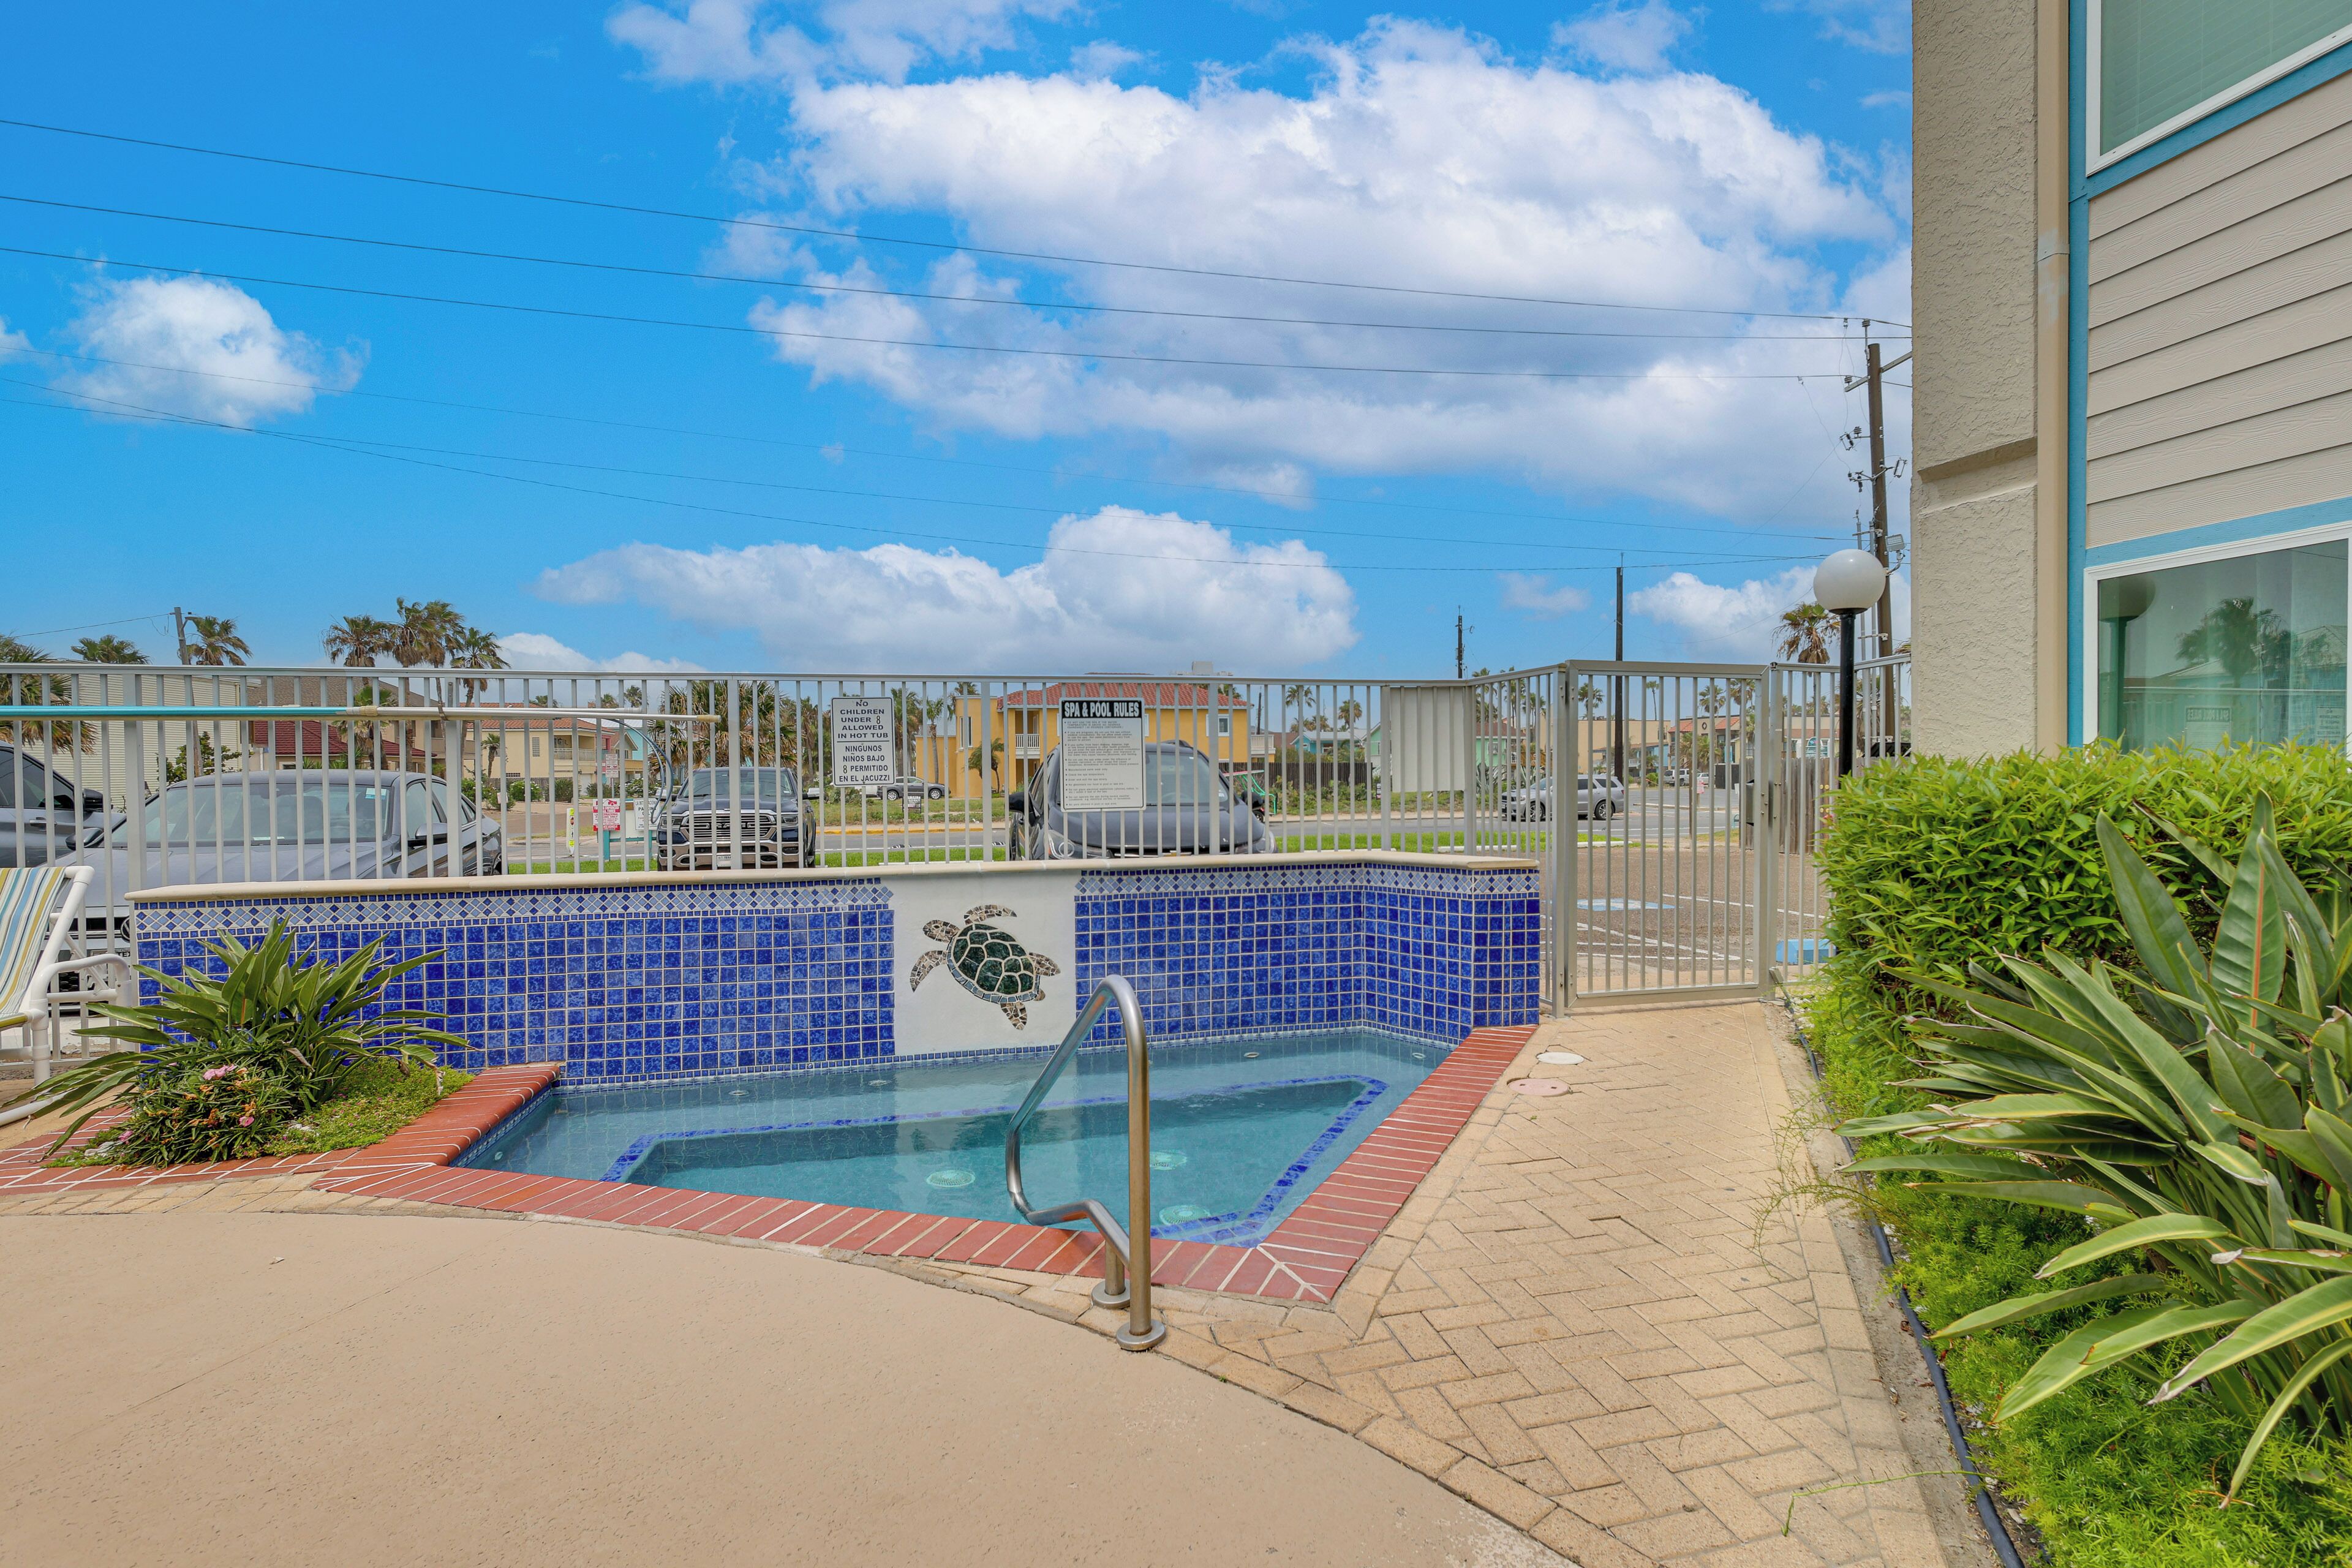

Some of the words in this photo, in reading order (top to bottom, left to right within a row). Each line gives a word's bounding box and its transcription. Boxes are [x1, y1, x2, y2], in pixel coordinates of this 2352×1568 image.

[1064, 702, 1080, 717] SPA
[1082, 702, 1088, 717] &
[1090, 702, 1112, 717] POOL
[1114, 702, 1140, 717] RULES
[876, 715, 881, 725] 8
[843, 752, 865, 762] NIÑOS
[843, 764, 848, 774] 8
